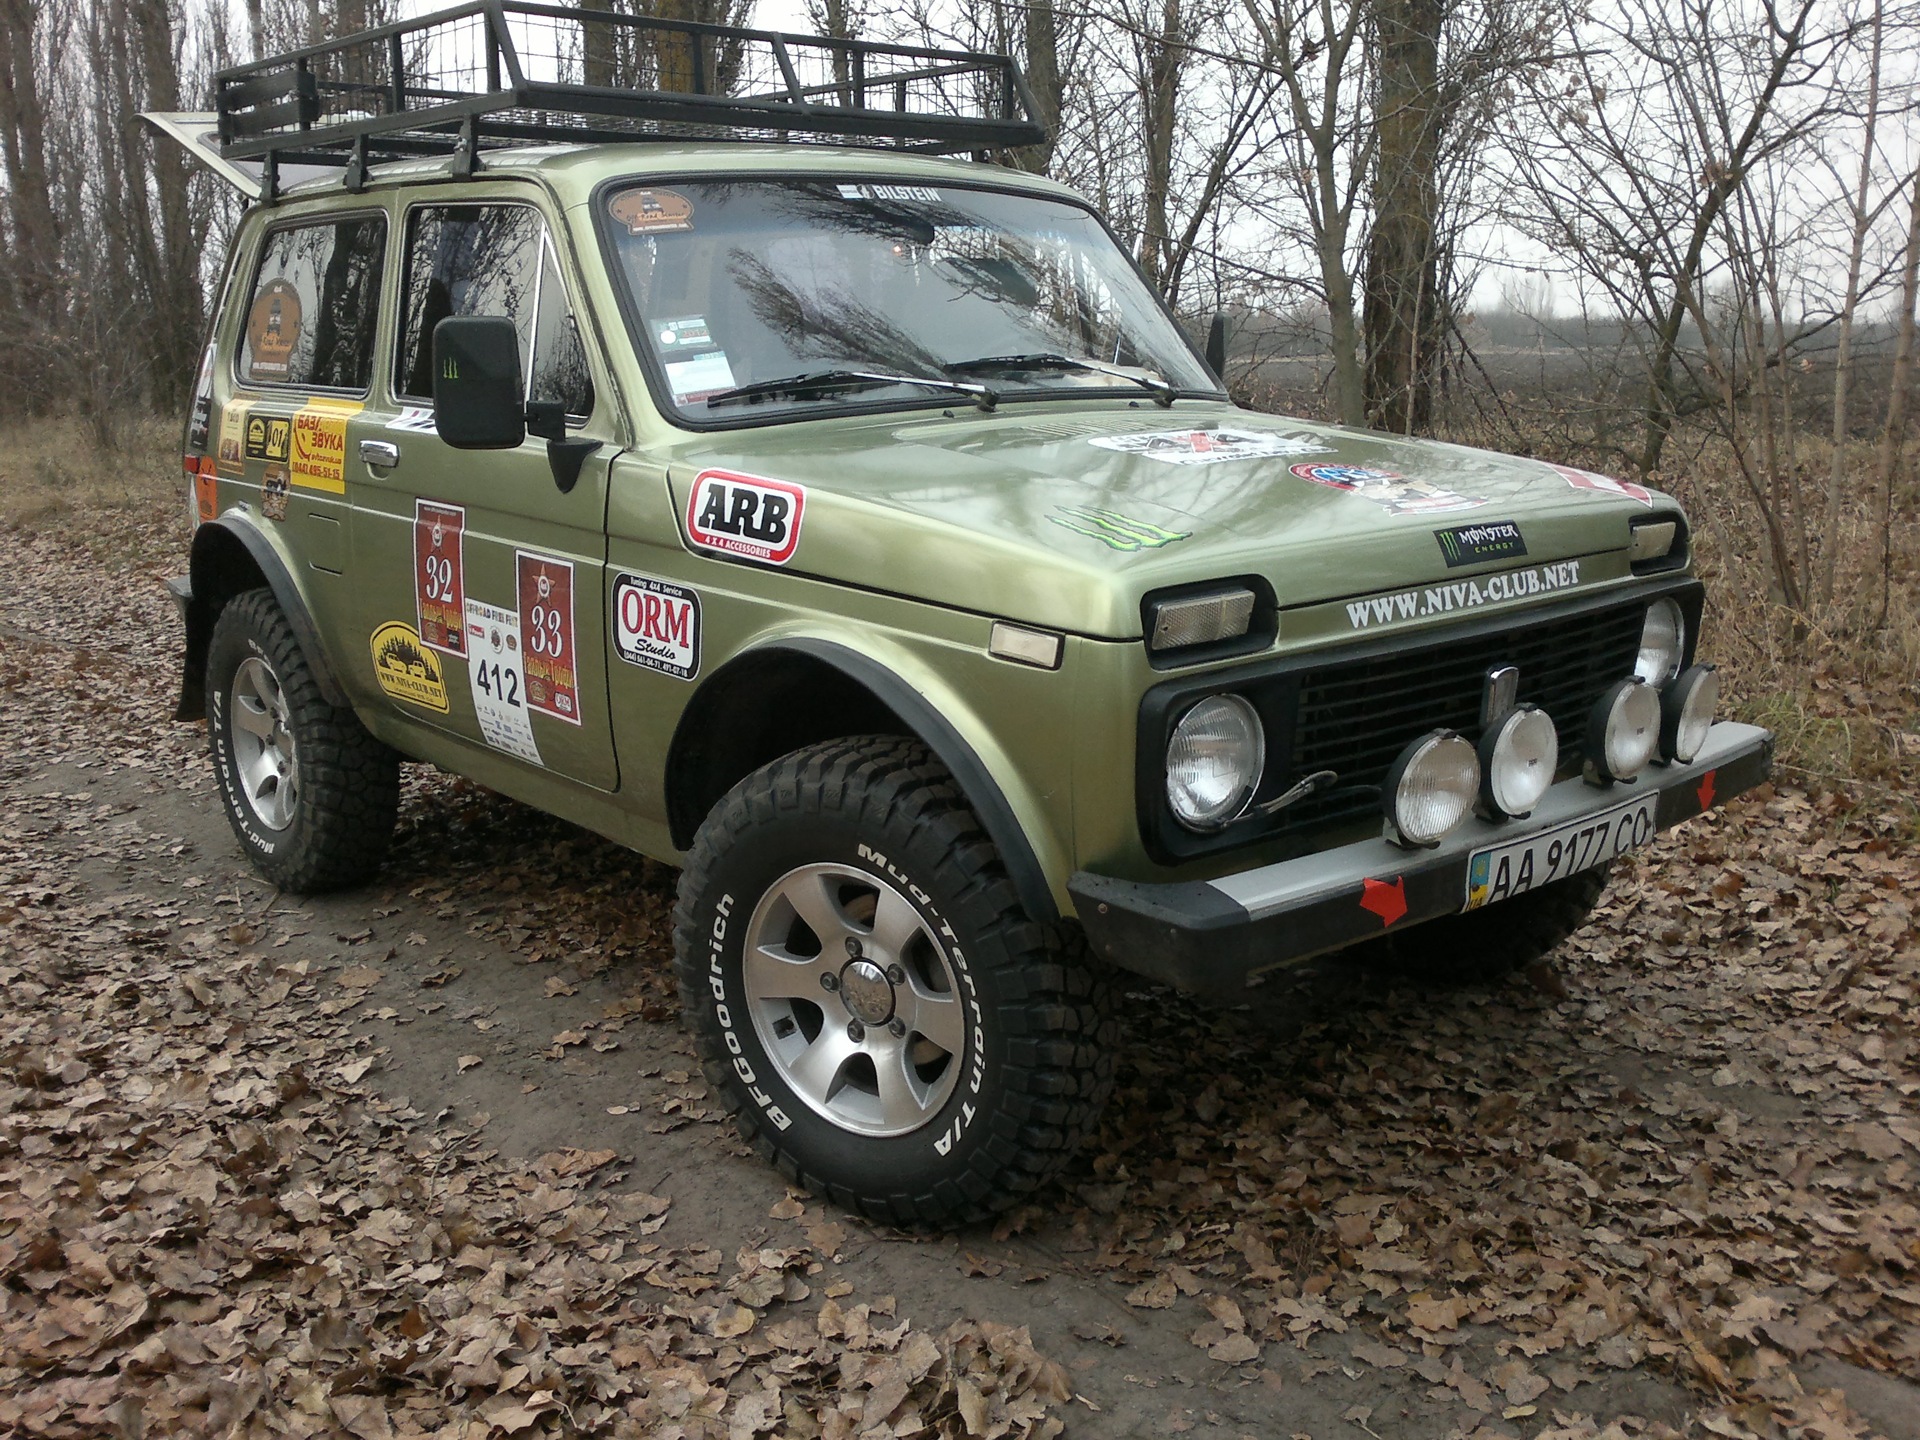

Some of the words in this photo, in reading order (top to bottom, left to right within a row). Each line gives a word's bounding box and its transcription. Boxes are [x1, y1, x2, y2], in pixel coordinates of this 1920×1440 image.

[872, 184, 942, 201] BILSTEIN
[311, 431, 343, 451] ЗВУКА
[698, 483, 789, 543] ARB
[1459, 525, 1518, 544] MONSTER
[725, 540, 771, 558] ACCESSORIES
[1475, 542, 1513, 553] ENERGY
[426, 555, 453, 603] 32
[630, 576, 647, 589] Tuning
[663, 585, 682, 597] Service
[1346, 561, 1580, 628] WWW.NIVA-CLUB.NET
[466, 602, 491, 618] OFFROAD
[531, 605, 563, 657] 33
[622, 589, 691, 649] ORM
[635, 639, 676, 659] Studio
[477, 659, 520, 708] 412
[213, 691, 222, 732] T/A
[217, 738, 275, 855] Mud-Terrain
[1489, 848, 1534, 903] AA
[1541, 821, 1611, 886] 9177
[1614, 806, 1649, 854] CO
[708, 893, 793, 1132] BFGoodrich
[857, 843, 988, 1095] Mud-Terrain
[934, 1100, 977, 1157] T/A
